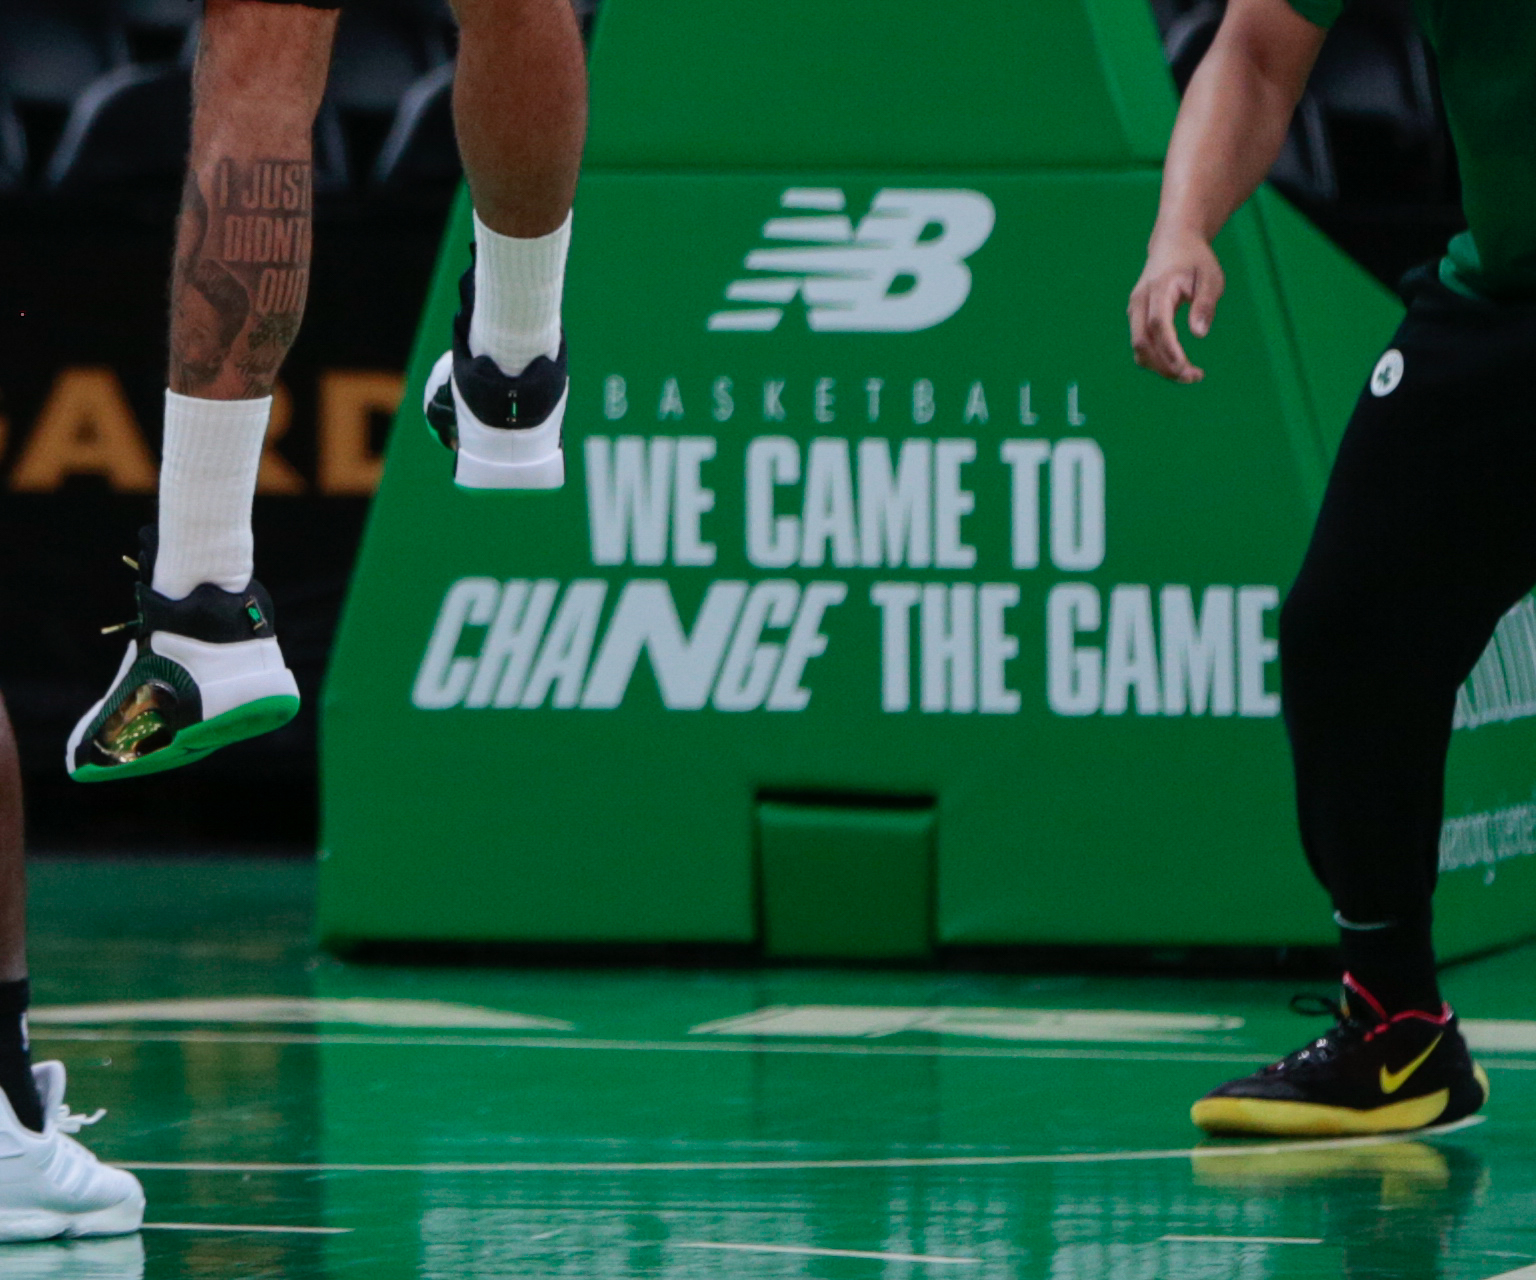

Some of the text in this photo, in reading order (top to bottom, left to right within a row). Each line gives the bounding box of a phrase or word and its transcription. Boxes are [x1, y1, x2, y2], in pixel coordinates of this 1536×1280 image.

[241, 161, 312, 210] JUST
[706, 187, 996, 332] NB
[603, 374, 1086, 426] BASKETBALL
[583, 436, 1107, 571] WE CAME TO
[410, 576, 1282, 717] CHANGE THE GAME
